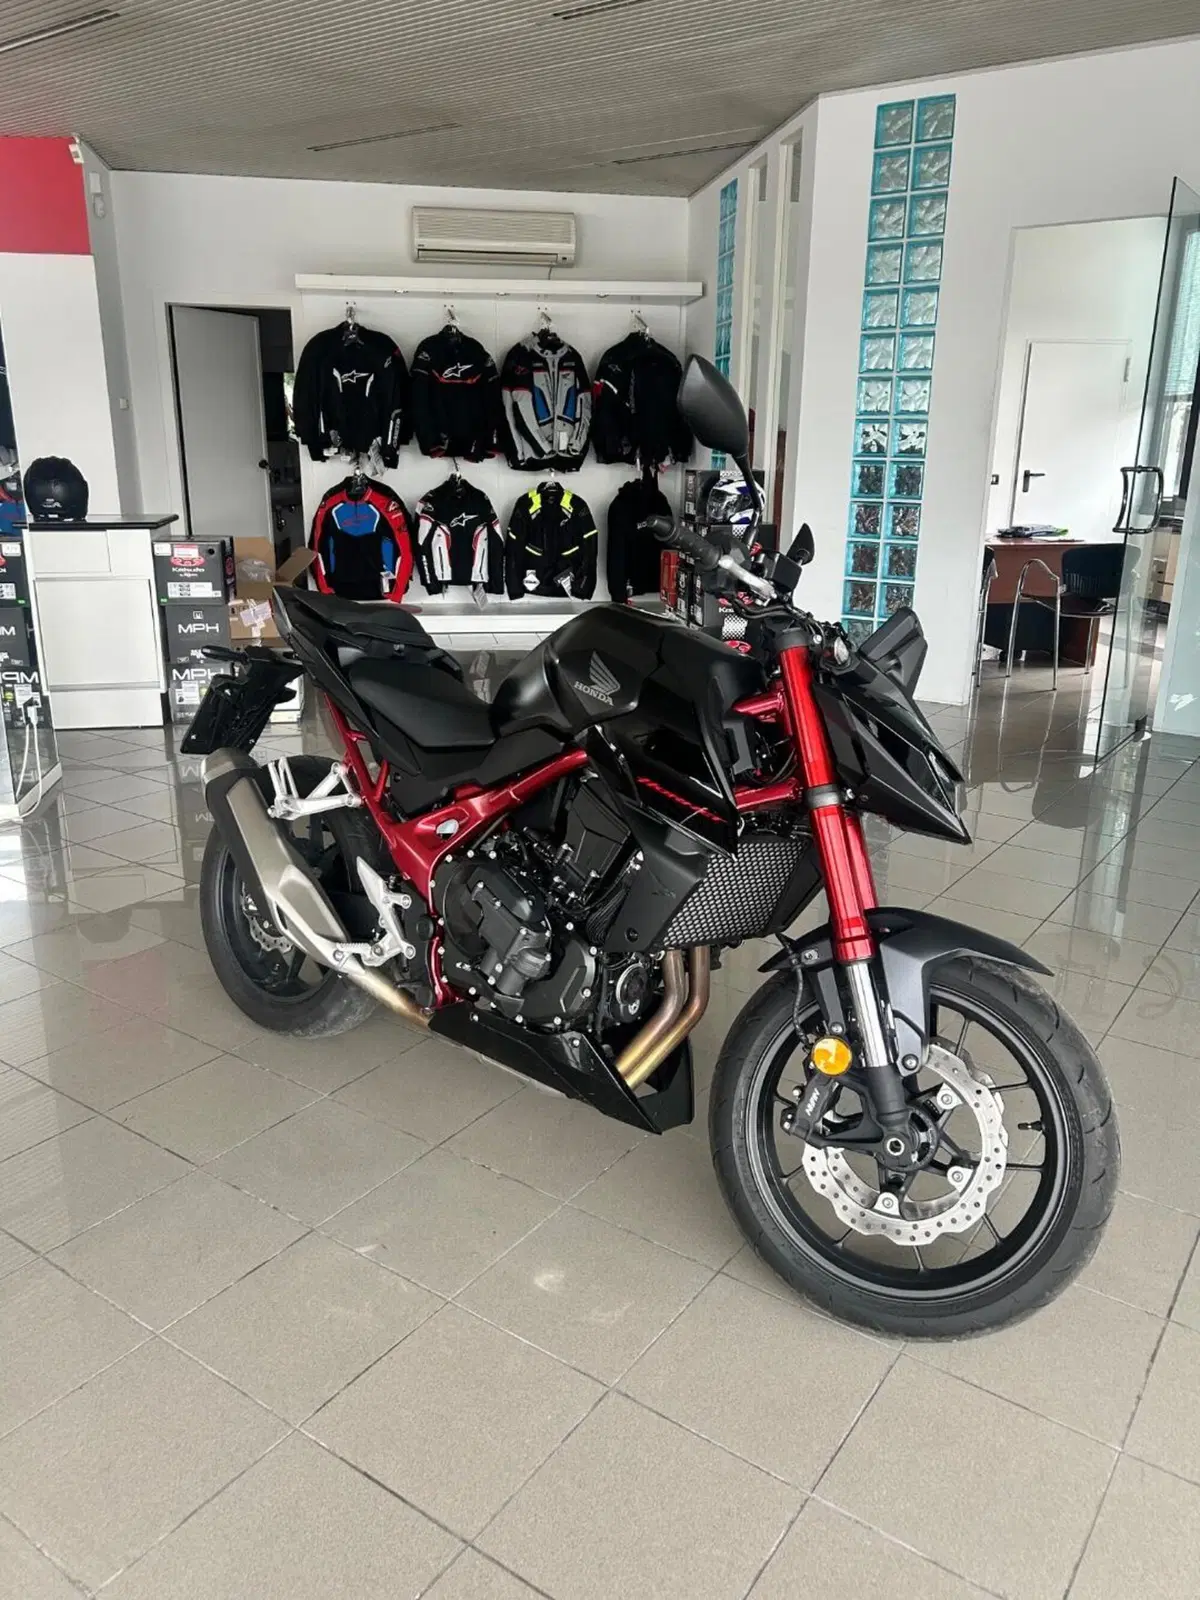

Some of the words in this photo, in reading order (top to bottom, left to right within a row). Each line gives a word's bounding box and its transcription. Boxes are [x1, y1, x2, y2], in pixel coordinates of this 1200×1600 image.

[177, 622, 220, 634] MPH
[172, 668, 225, 681] MPH
[573, 681, 615, 706] HONDA
